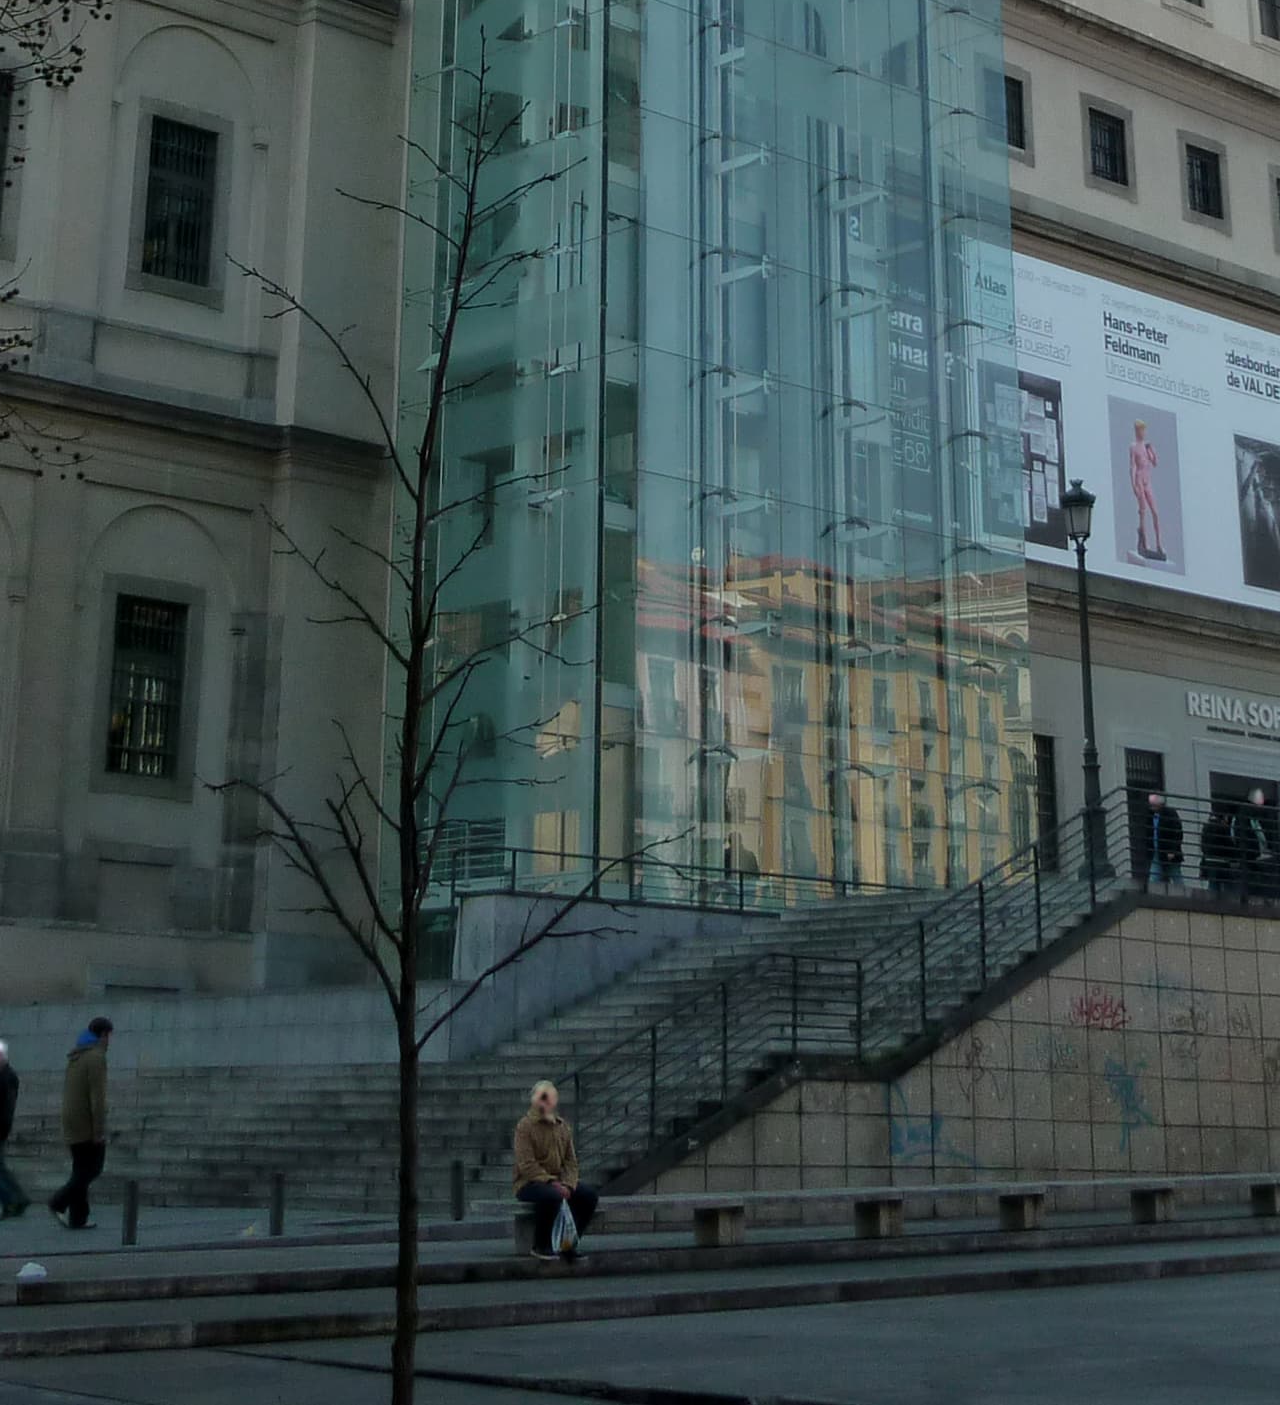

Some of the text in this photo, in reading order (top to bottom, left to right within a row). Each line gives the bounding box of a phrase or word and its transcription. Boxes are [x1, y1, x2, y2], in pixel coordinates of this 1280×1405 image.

[975, 269, 1008, 296] Atlas
[1103, 310, 1169, 346] Hans-Peter
[1104, 334, 1161, 366] Feldmann
[1226, 370, 1241, 389] de
[1241, 374, 1265, 397] VAL
[1185, 691, 1247, 725] REINA
